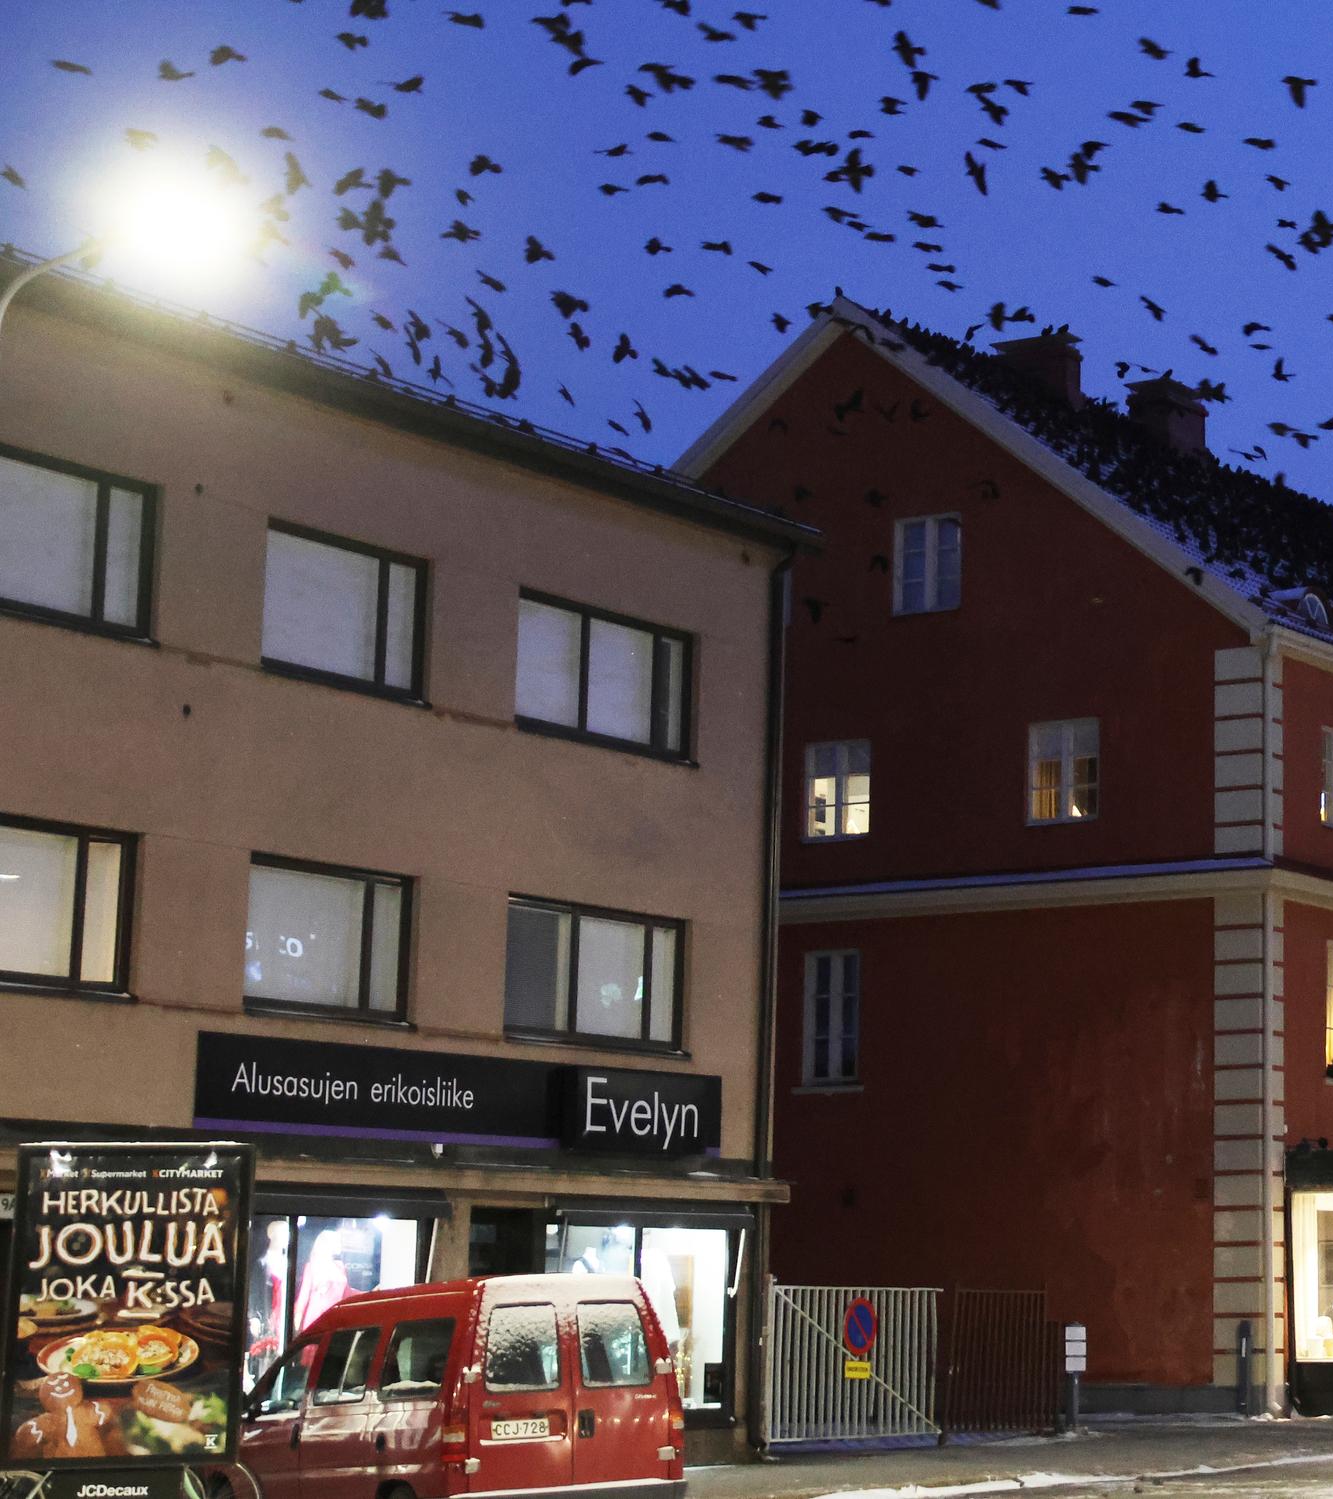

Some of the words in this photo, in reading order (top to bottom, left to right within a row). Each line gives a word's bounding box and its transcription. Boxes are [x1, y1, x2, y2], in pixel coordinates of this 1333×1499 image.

[230, 1061, 358, 1104] Alusasujen
[371, 1074, 474, 1109] erikoisliike
[584, 1076, 699, 1150] Evelyn
[41, 1187, 220, 1217] HERKULLISTA
[28, 1219, 227, 1270] JOULUA
[36, 1274, 117, 1303] JOKA
[494, 1420, 547, 1437] CCJ-728
[76, 1484, 149, 1498] JCDecaux
